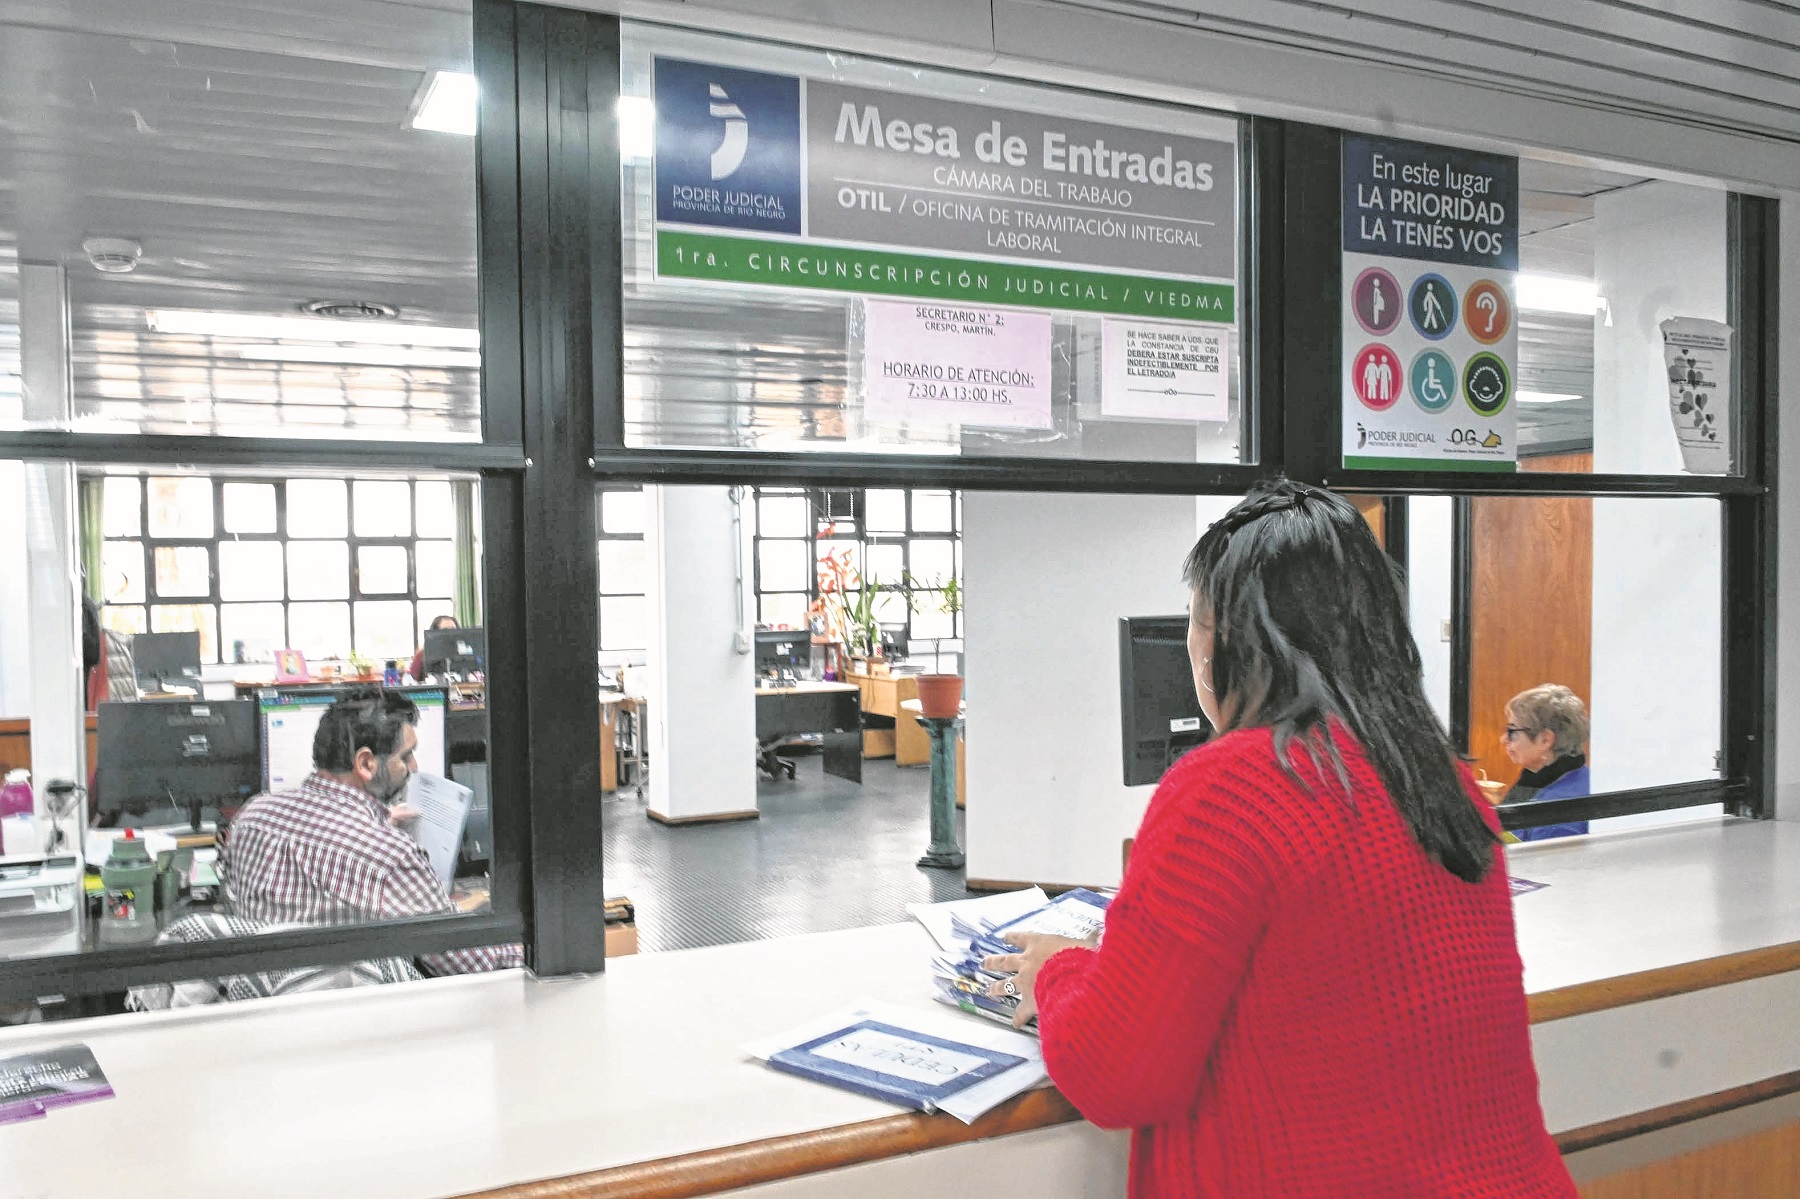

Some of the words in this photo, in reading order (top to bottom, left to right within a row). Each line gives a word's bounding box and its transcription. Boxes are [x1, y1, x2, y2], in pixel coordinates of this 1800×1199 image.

[834, 101, 960, 158] Mesa
[974, 119, 1028, 167] de
[1043, 130, 1214, 192] Entradas
[933, 163, 1015, 194] CÁMARA
[1020, 177, 1053, 200] DEL
[1057, 181, 1132, 208] TRABAJO
[1372, 153, 1396, 181] En
[1401, 162, 1441, 187] este
[1445, 163, 1493, 199] lugar
[672, 199, 721, 215] PROVINCIA
[723, 205, 736, 216] DE
[756, 208, 786, 221] NEGRO
[673, 184, 721, 204] PODER
[724, 189, 784, 212] JUDICIAL
[1357, 182, 1385, 211] LA
[1390, 187, 1506, 226] PRIORIDAD
[837, 186, 892, 214] OTIL
[898, 193, 907, 215] /
[912, 198, 984, 223] OFICINA
[988, 207, 1011, 228] DE
[1014, 209, 1126, 240] TRAMITACIÓN
[1131, 223, 1202, 248] INTEGRAL
[987, 228, 1062, 254] LABORAL
[1360, 215, 1387, 242] LA
[1391, 219, 1454, 250] TENÉS
[1458, 227, 1503, 256] VOS
[676, 246, 728, 268] 1ra.
[748, 252, 988, 290] CIRCUNSCRIPCIÓN
[1004, 276, 1108, 301] JUDICIAL
[1123, 287, 1130, 301] /
[1145, 290, 1223, 311] VIEDMA
[915, 307, 976, 321] SECRETARIO
[924, 321, 960, 334] CRESPO,
[1127, 330, 1137, 339] SE
[1138, 332, 1157, 340] HACE
[1157, 333, 1181, 342] SABER
[1204, 337, 1219, 346] QUE
[1127, 340, 1136, 348] LA
[1141, 341, 1185, 352] CONSTANCIA
[1190, 345, 1200, 353] DE
[1157, 352, 1180, 361] ESTAR
[1181, 354, 1220, 364] SUSCRIPTA
[882, 361, 944, 380] HORARIO
[948, 367, 965, 382] DE
[968, 368, 1035, 387] ATENCIÓN:
[1127, 359, 1198, 371] INDEFECTIBLEMENTE
[1205, 364, 1220, 374] POR
[1127, 368, 1136, 376] EL
[907, 382, 937, 400] 7:30
[940, 387, 950, 399] A
[954, 387, 988, 402] 13:00
[992, 389, 1013, 404] HS.
[1368, 430, 1398, 442] PODER
[1398, 431, 1437, 444] JUDICIAL
